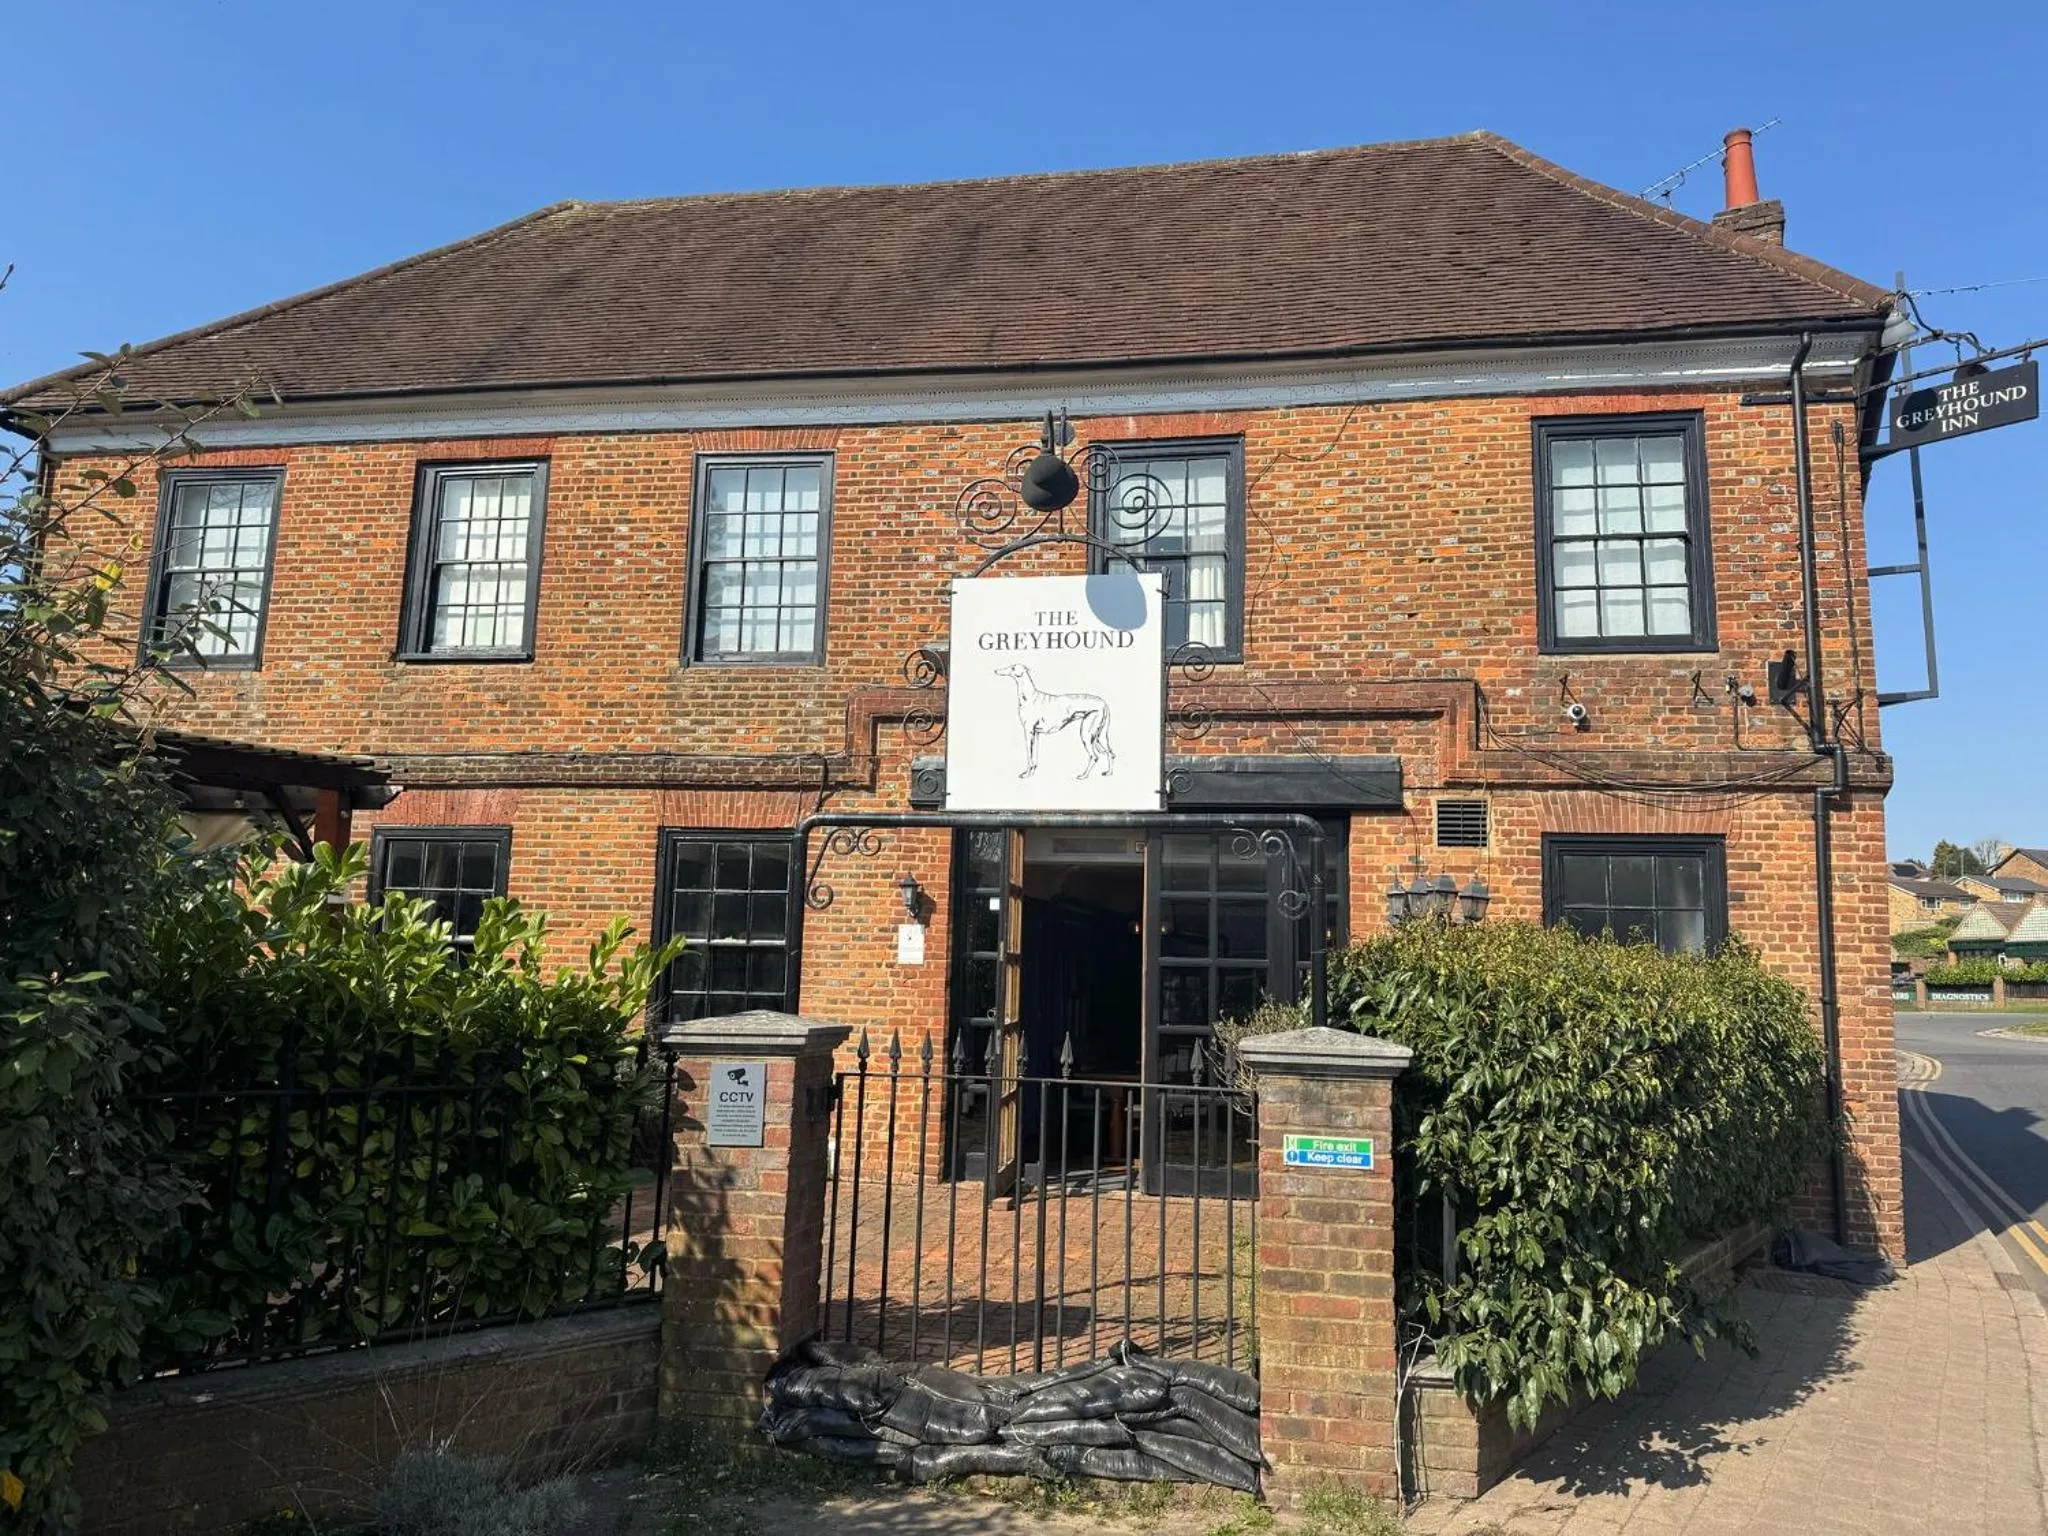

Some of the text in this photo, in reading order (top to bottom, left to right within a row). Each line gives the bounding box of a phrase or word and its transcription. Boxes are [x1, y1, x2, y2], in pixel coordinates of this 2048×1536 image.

[1938, 381, 1980, 402] THE
[1896, 385, 2027, 428] GREYHOUND
[1941, 412, 1979, 433] INN
[1034, 610, 1079, 627] THE
[978, 630, 1134, 651] GREYHOUND
[1931, 992, 1989, 1001] DIAGNOSTICS
[719, 1091, 755, 1103] CCTV
[1312, 1140, 1358, 1152] Fire exit
[1307, 1152, 1364, 1165] Keep clear
